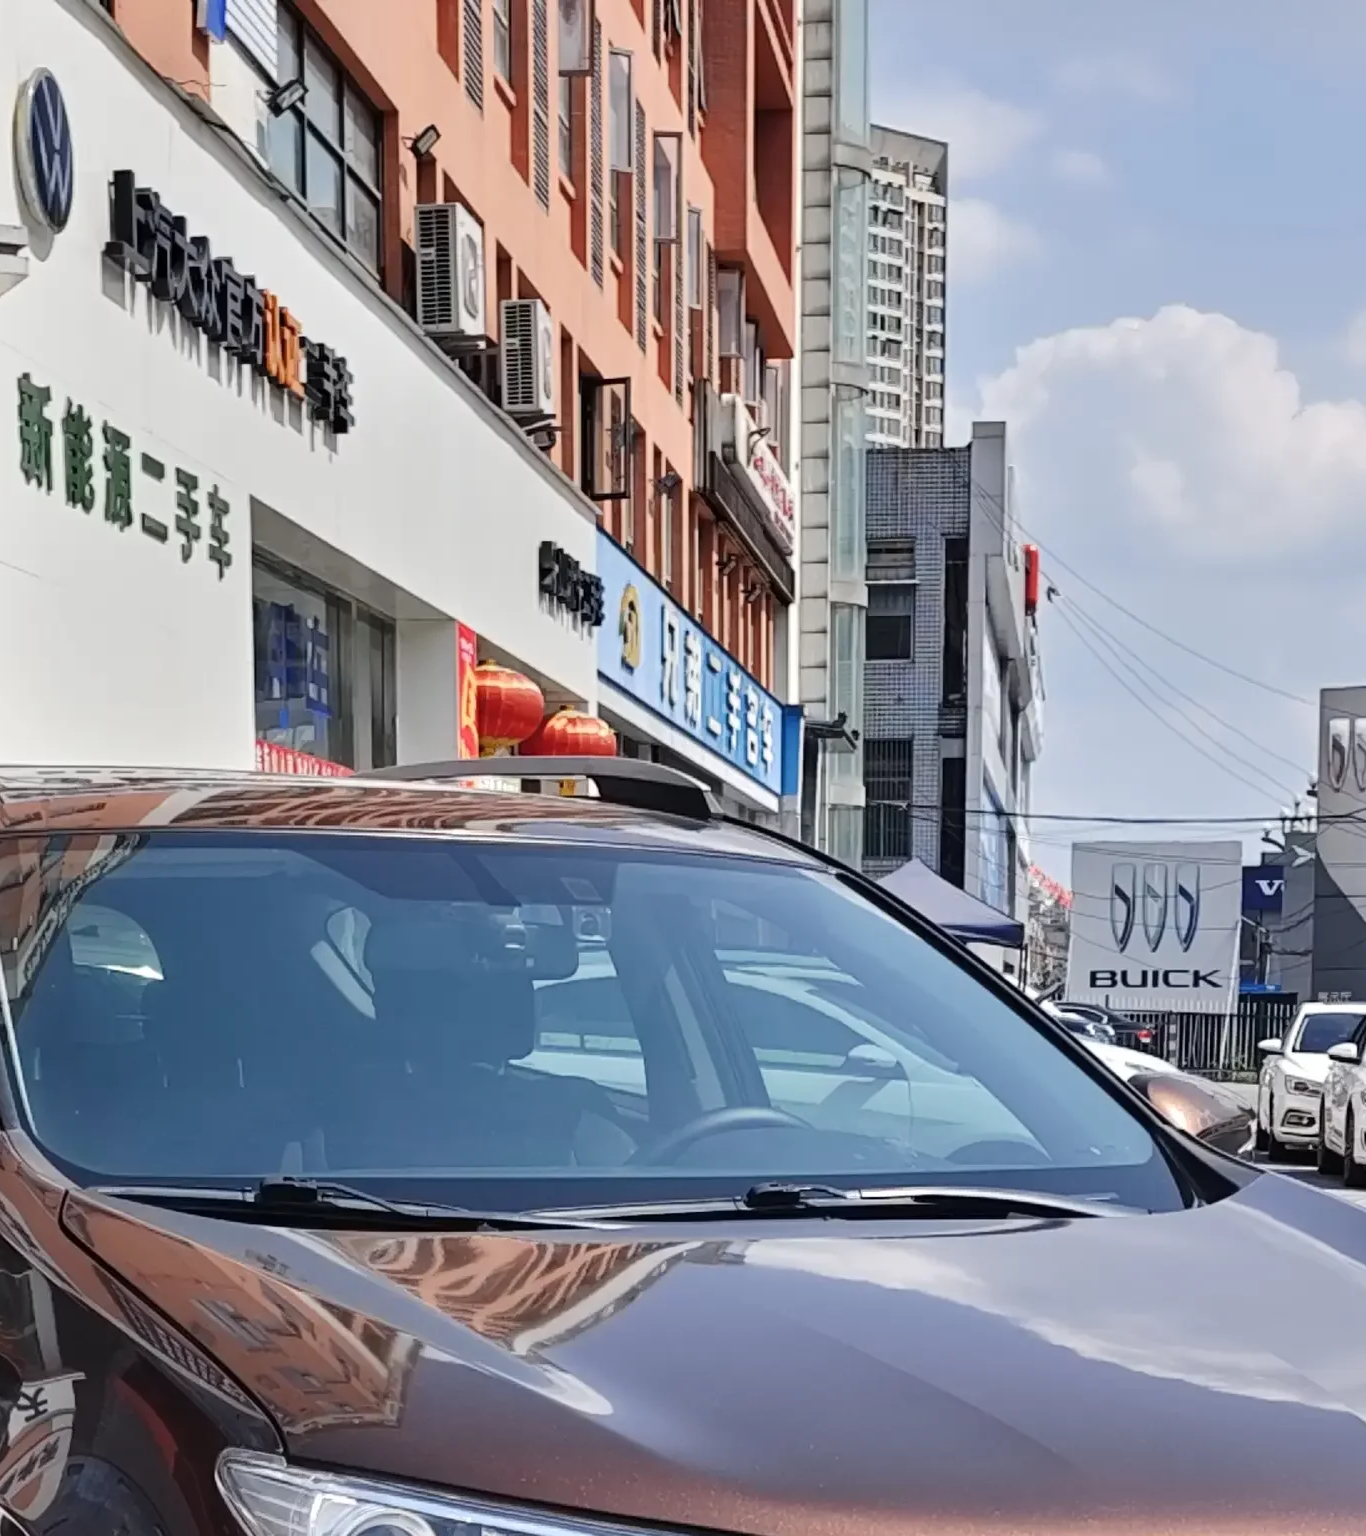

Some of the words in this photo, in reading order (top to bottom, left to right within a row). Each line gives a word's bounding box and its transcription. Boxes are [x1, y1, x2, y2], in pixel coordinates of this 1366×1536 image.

[17, 373, 232, 581] 新能源二手车
[1089, 970, 1223, 988] BUICK
